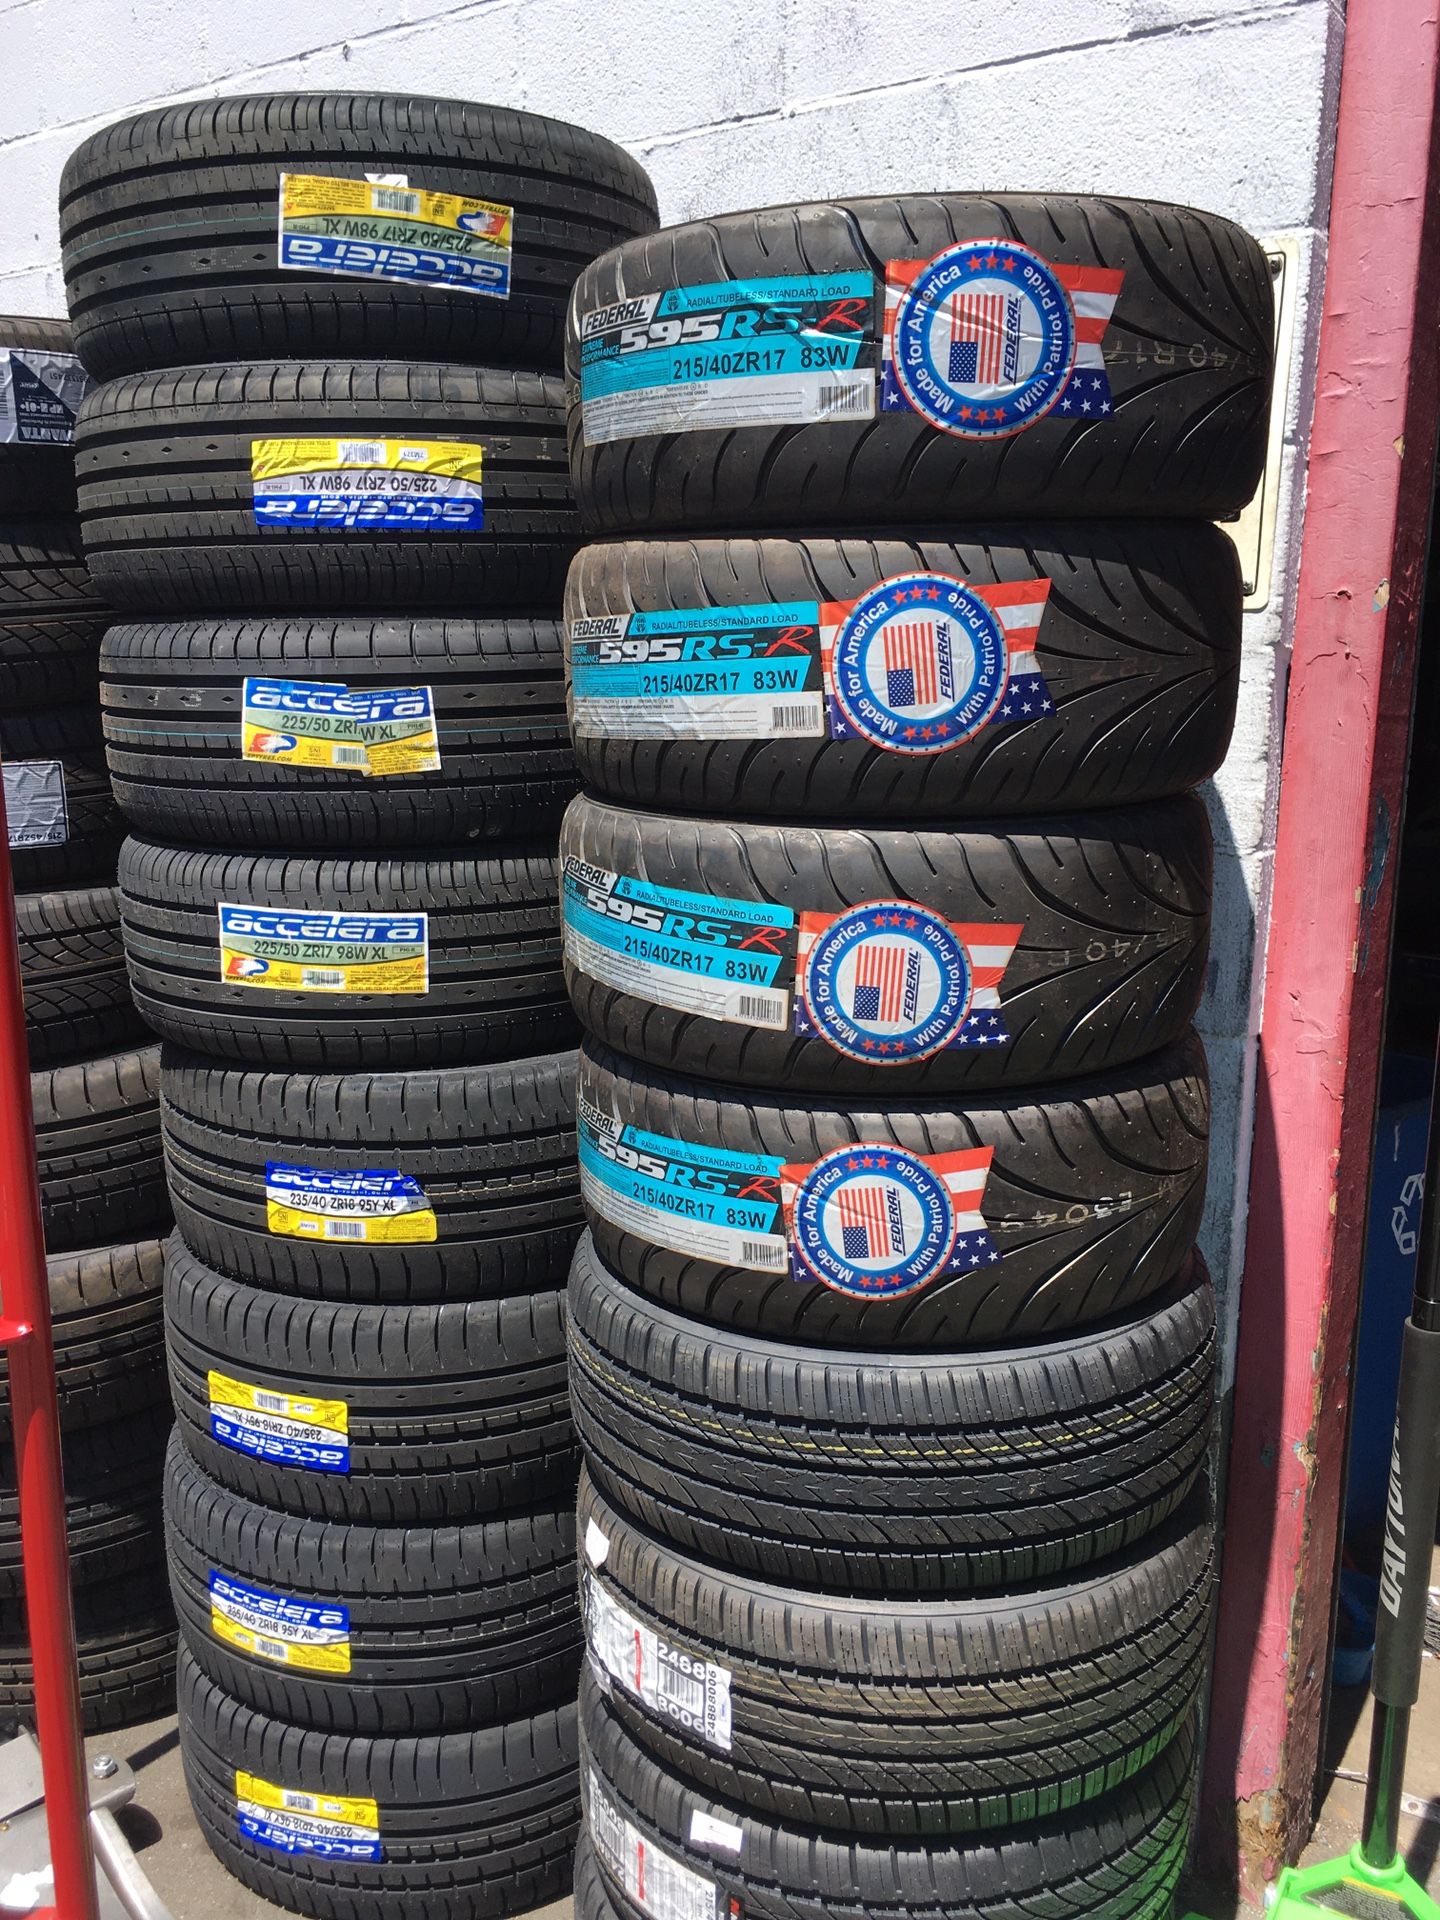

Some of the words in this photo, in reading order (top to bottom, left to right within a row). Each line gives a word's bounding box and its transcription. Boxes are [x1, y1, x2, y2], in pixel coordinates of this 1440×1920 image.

[323, 219, 340, 234] XL
[344, 223, 378, 238] 98W
[383, 227, 417, 243] ZR17
[421, 231, 472, 253] 225/50
[288, 239, 502, 286] accelera
[687, 287, 818, 307] RADIAL/TUBELESS/STANDARD
[821, 285, 850, 297] LOAD
[908, 264, 961, 332] America
[1023, 266, 1057, 311] Pride
[586, 299, 646, 333] FEDERAL
[907, 342, 924, 366] for
[1002, 297, 1021, 383] FEDERAL
[1044, 315, 1064, 374] Patriot
[673, 349, 785, 380] 215/40ZR17
[800, 345, 850, 369] 83W
[917, 368, 954, 414] Made
[1014, 371, 1049, 414] With
[300, 476, 316, 490] XL
[320, 477, 350, 490] 98W
[356, 477, 386, 490] ZR17
[392, 477, 437, 492] 225/50
[255, 499, 474, 525] accelera
[652, 616, 769, 630] RADIAL/TUBELESS/STANDARD
[772, 614, 798, 623] LOAD
[948, 592, 984, 628] Pride
[573, 619, 619, 636] FEDERAL
[844, 600, 889, 667] America
[935, 623, 953, 700] FEDERAL
[979, 628, 995, 686] Patriot
[643, 672, 740, 693] 215/40ZR17
[754, 669, 798, 689] 83W
[848, 671, 862, 697] for
[859, 701, 898, 735] Made
[956, 692, 986, 725] With
[282, 715, 330, 733] 225/50
[380, 725, 396, 739] XL
[565, 856, 607, 887] FEDERAL
[636, 890, 746, 919] RADIAL/TUBELESS/STANDARD
[749, 911, 774, 923] LOAD
[227, 913, 419, 940] accelera
[254, 940, 299, 956] 225/50
[303, 944, 331, 958] ZR17
[337, 946, 368, 959] 98W
[372, 947, 388, 960] XL
[624, 936, 714, 972] 215/40ZR17
[725, 960, 769, 983] 83W
[816, 922, 867, 976] America
[924, 925, 957, 962] Pride
[817, 979, 834, 1002] for
[902, 951, 919, 1021] FEDERAL
[941, 962, 960, 1018] Patriot
[823, 1005, 858, 1044] Made
[913, 1016, 946, 1047] With
[580, 1098, 614, 1134] FEDERAL
[641, 1140, 743, 1170] RADIAL/TUBELESS/STANDARD
[744, 1164, 768, 1173] LOAD
[804, 1167, 842, 1221] America
[896, 1161, 933, 1198] Pride
[290, 1193, 326, 1207] 235/40
[331, 1198, 355, 1210] ZR18
[359, 1199, 378, 1211] 95Y
[382, 1201, 397, 1211] XL
[633, 1182, 715, 1220] 215/40ZR17
[727, 1209, 767, 1229] 83W
[808, 1227, 826, 1247] for
[890, 1188, 906, 1255] FEDERAL
[926, 1197, 942, 1244] Patriot
[818, 1247, 854, 1283] Made
[907, 1246, 932, 1276] With
[245, 1415, 260, 1427] 95Y
[262, 1420, 283, 1434] ZR18
[287, 1425, 322, 1441] 235/40
[215, 1421, 343, 1465] accelera
[213, 1578, 343, 1625] accelera
[258, 1617, 279, 1632] ZR18
[282, 1623, 299, 1637] 95Y
[302, 1628, 313, 1640] XL
[658, 1642, 705, 1680] 2488
[658, 1695, 705, 1733] 8006
[707, 1670, 716, 1738] 24888006
[317, 1824, 352, 1838] 235/40
